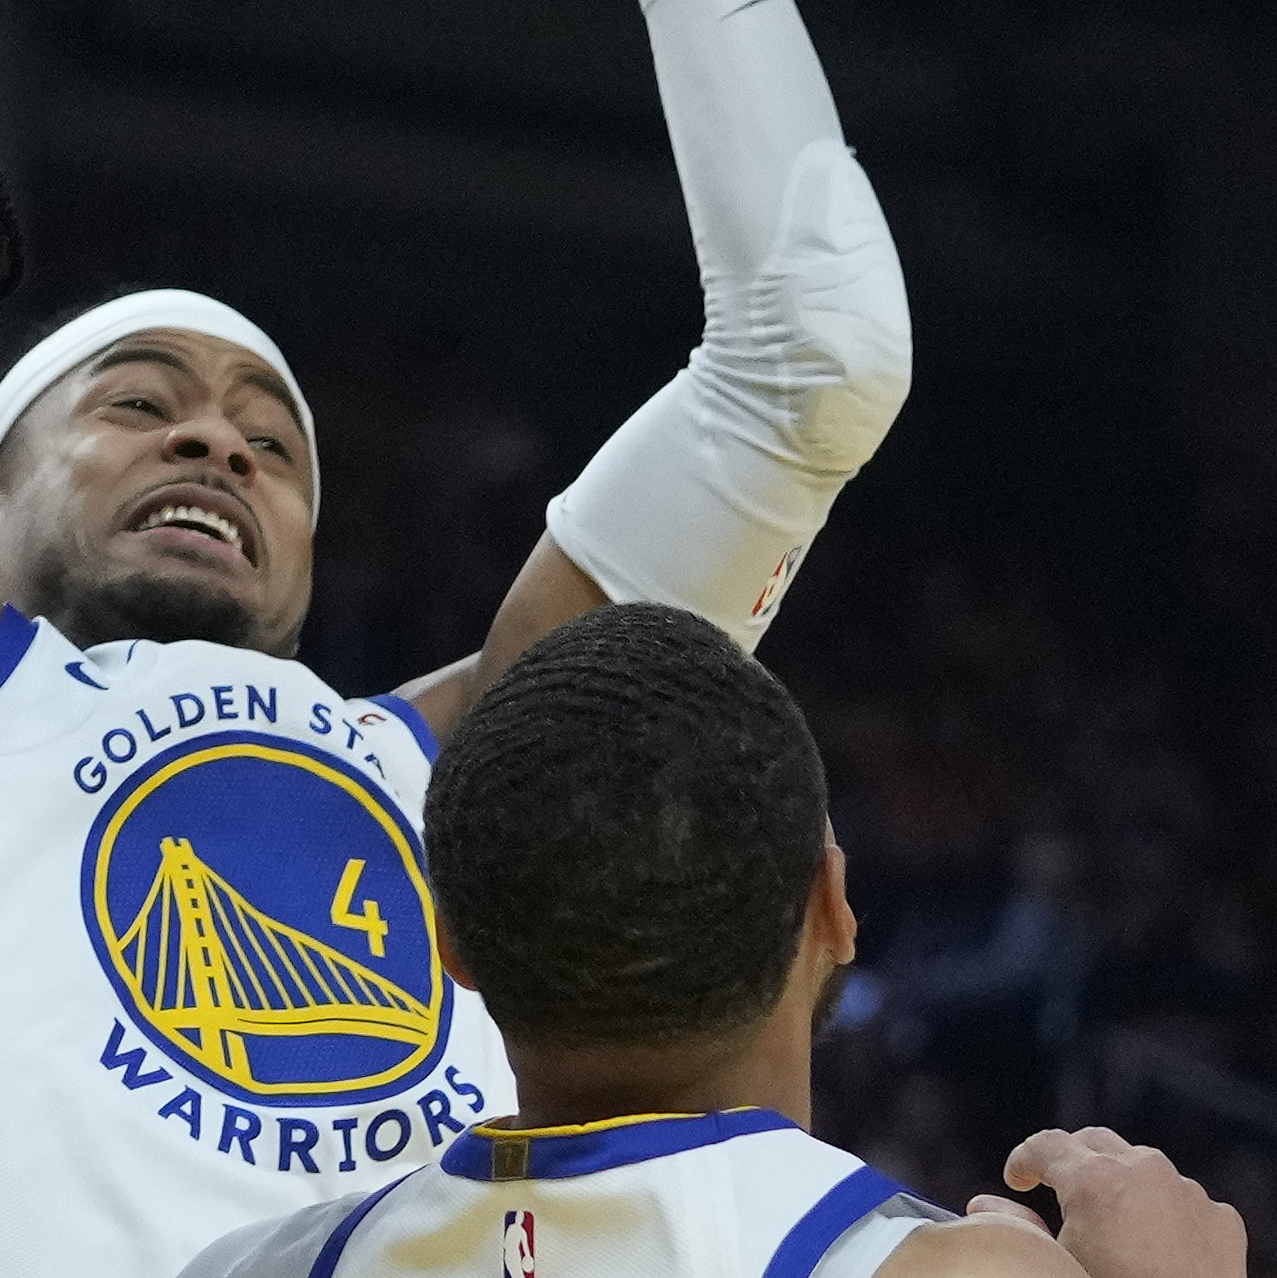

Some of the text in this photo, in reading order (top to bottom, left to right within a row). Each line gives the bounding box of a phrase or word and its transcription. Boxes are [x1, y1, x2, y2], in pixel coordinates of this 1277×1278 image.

[73, 684, 278, 794] GOLDEN
[330, 859, 388, 957] 4
[99, 1016, 485, 1174] WARRIORS
